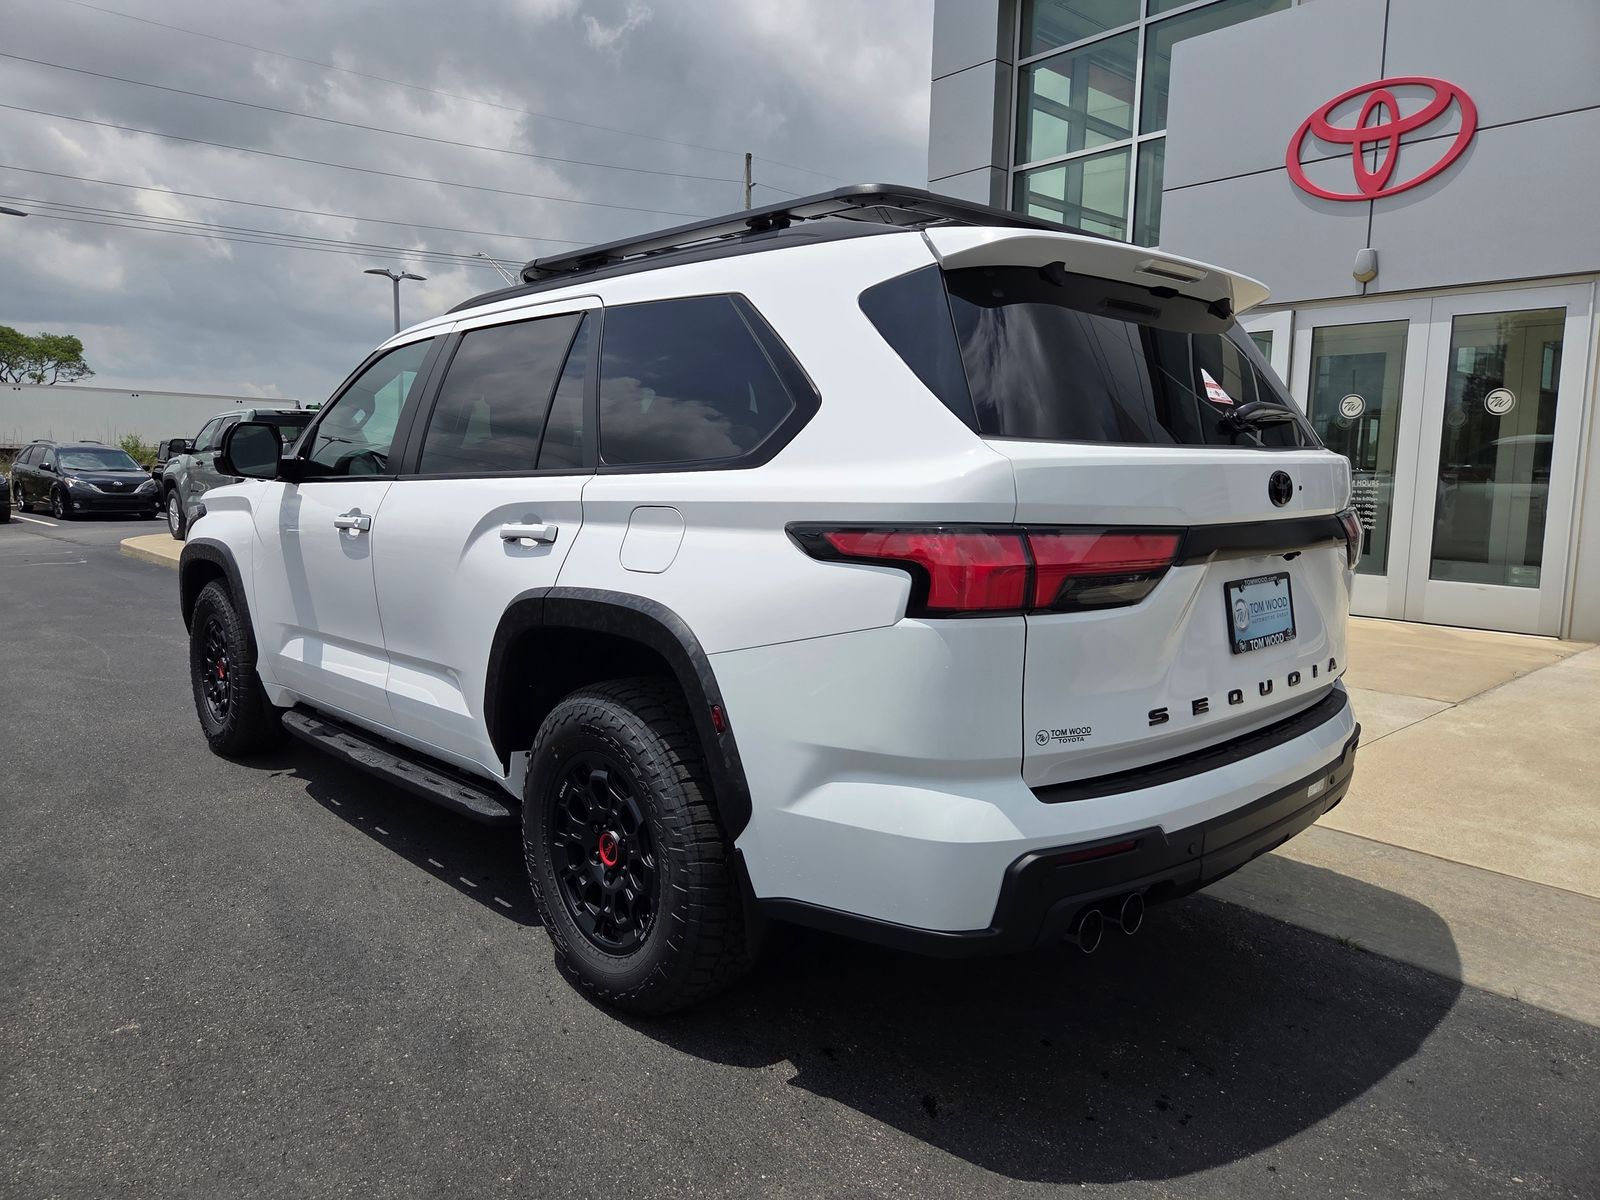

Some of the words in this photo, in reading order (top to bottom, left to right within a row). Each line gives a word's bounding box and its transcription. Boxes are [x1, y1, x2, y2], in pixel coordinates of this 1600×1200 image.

[1249, 602, 1265, 614] TOM
[1265, 597, 1288, 611] WOOD
[1250, 638, 1265, 651] TOM
[1265, 633, 1285, 647] WOOD
[1148, 657, 1338, 727] SEQUOIA
[1051, 728, 1068, 737] TOM
[1068, 726, 1092, 736] WOOD
